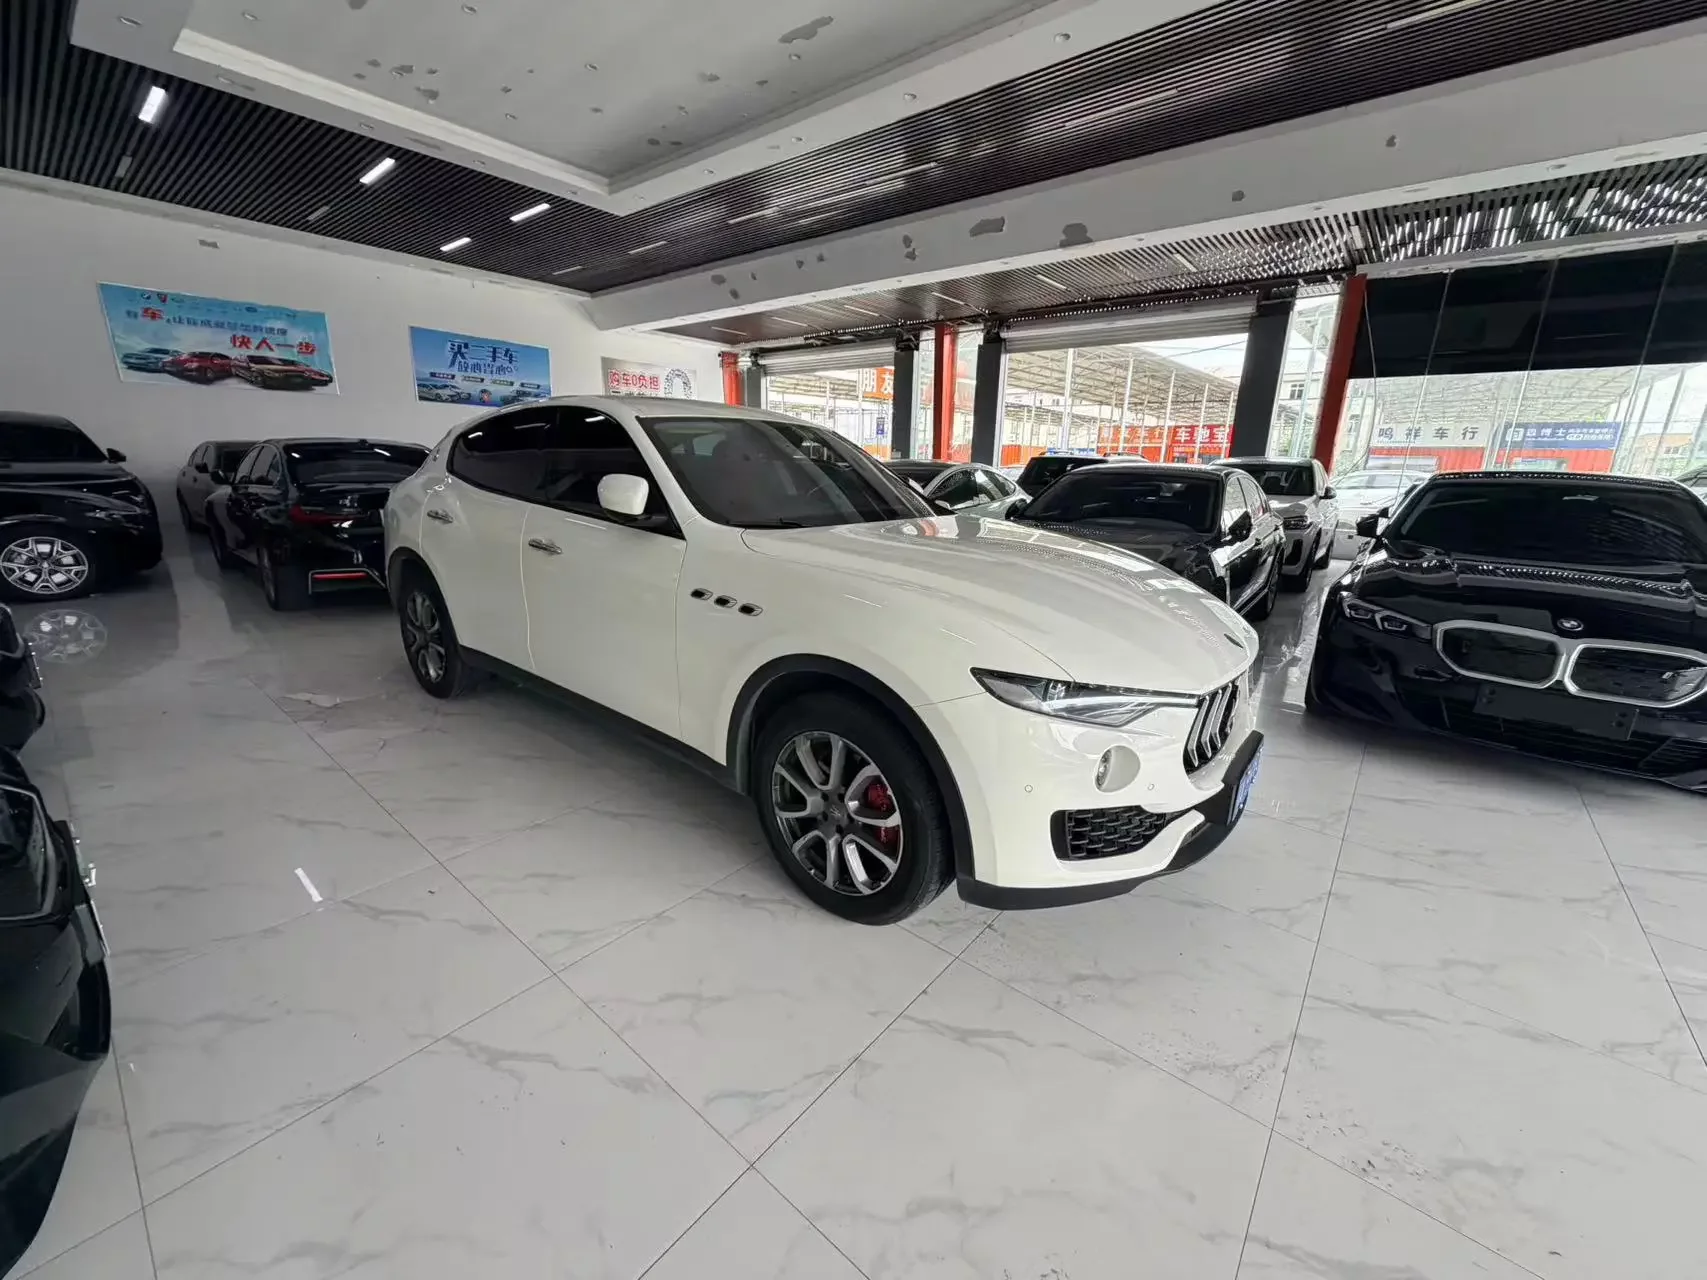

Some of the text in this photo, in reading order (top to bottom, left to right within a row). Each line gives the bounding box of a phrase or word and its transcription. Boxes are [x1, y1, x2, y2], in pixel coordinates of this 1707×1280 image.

[230, 333, 316, 355] 快人一步
[447, 340, 518, 368] 买二手车
[609, 370, 660, 390] 购车0负担
[1378, 426, 1479, 441] 鸣祥车行
